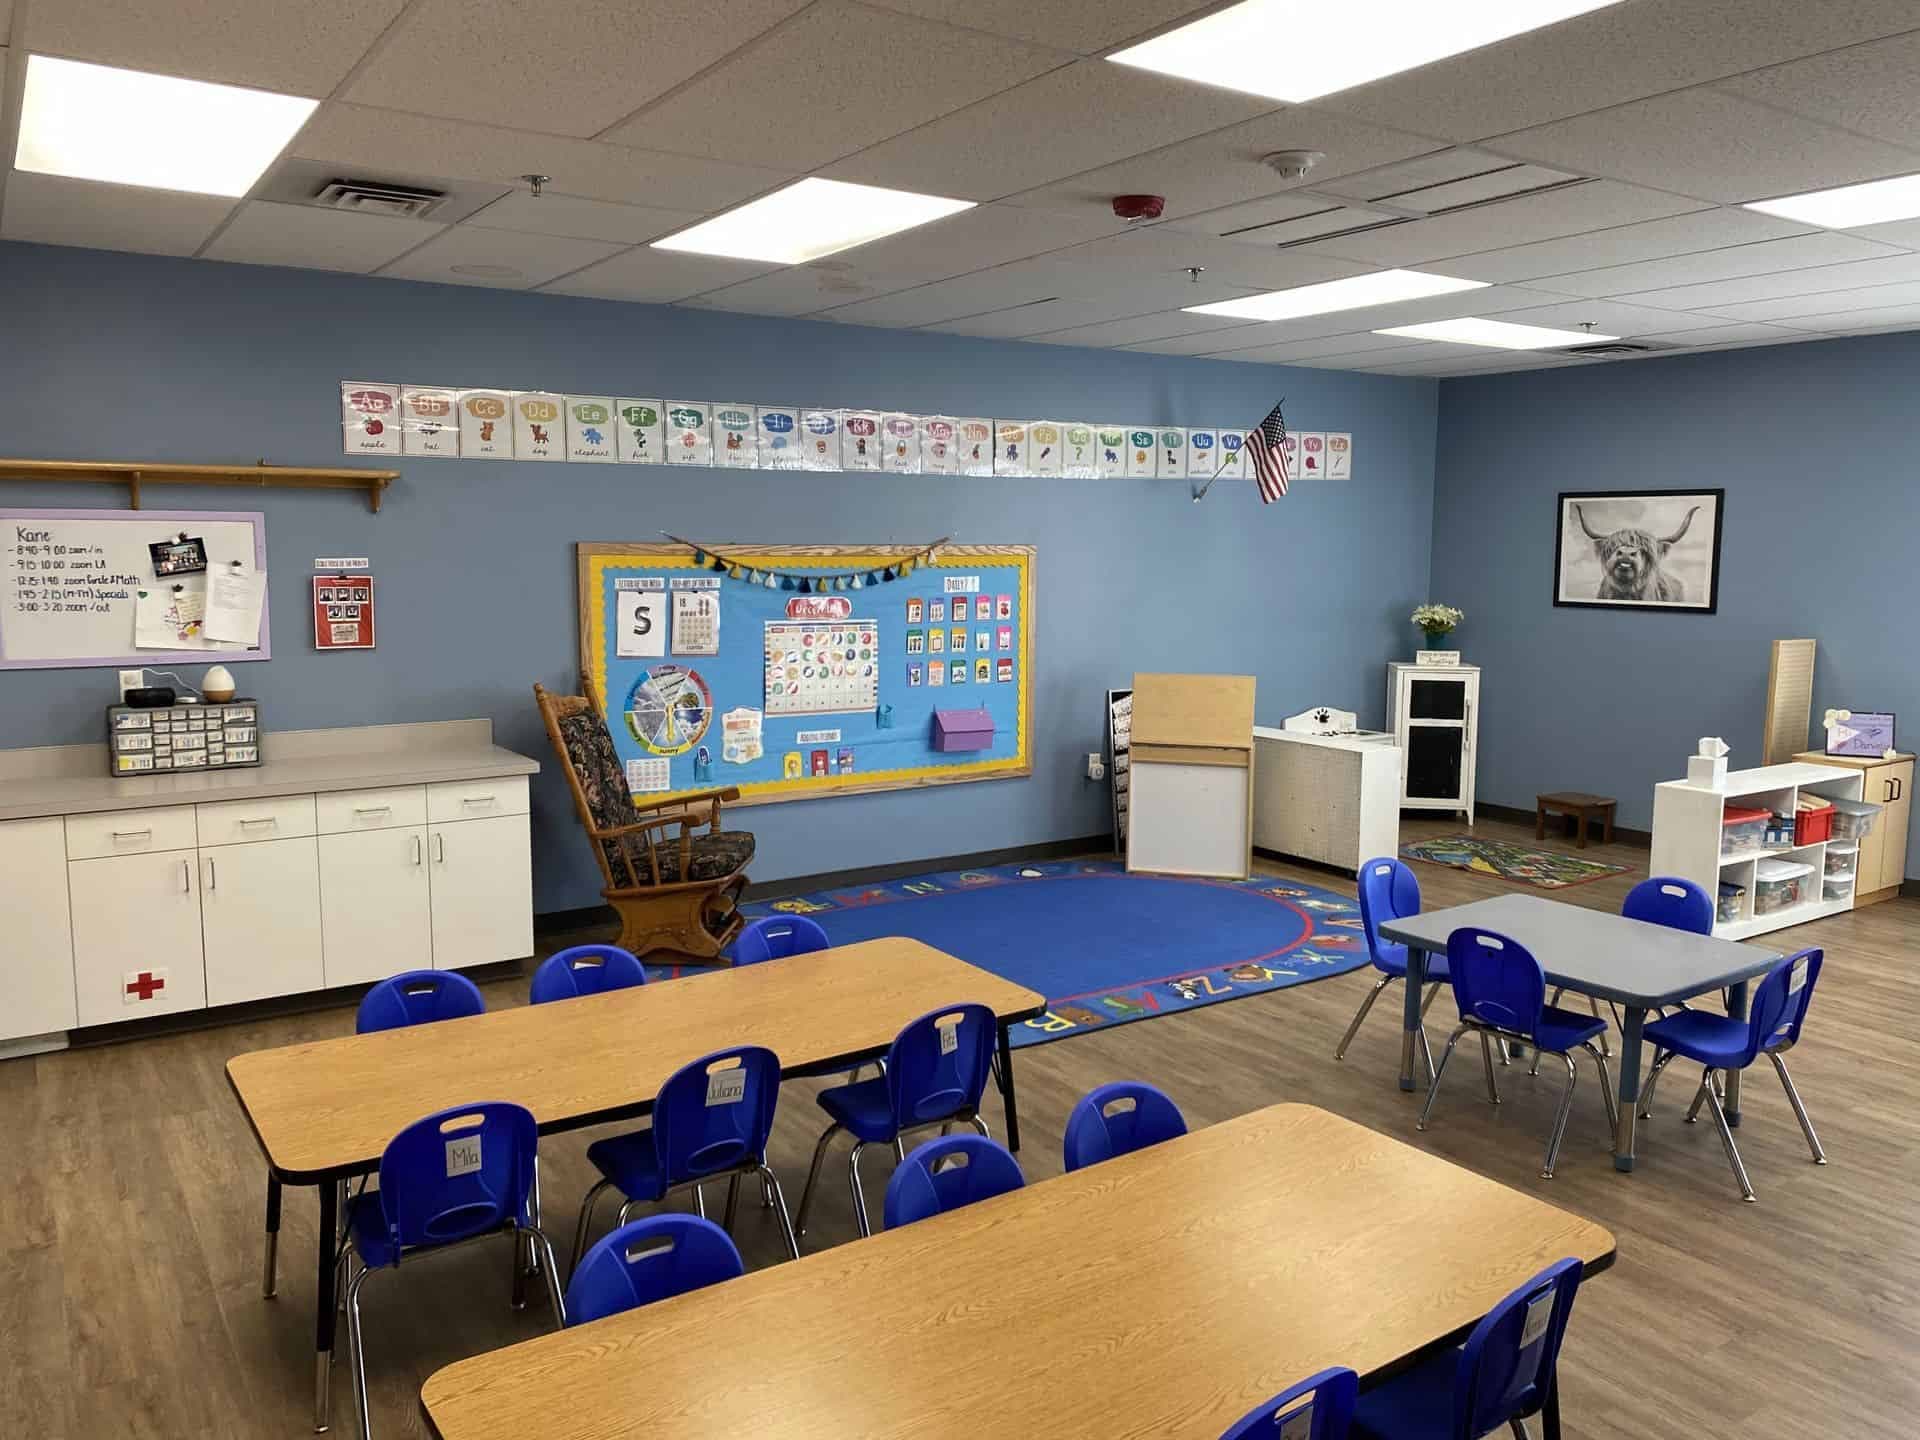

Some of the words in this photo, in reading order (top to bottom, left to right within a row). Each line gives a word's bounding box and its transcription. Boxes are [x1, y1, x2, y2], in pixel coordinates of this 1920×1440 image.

[476, 400, 496, 415] Cc
[528, 402, 548, 418] Dd
[581, 405, 600, 420] Ee
[631, 407, 648, 422] Ff
[678, 410, 697, 428] Gg
[853, 419, 869, 434] Kk
[1196, 437, 1209, 447] Uu
[1226, 436, 1238, 447] Vv
[16, 525, 50, 542] Kane
[633, 606, 652, 636] S
[452, 1146, 480, 1169] Mila
